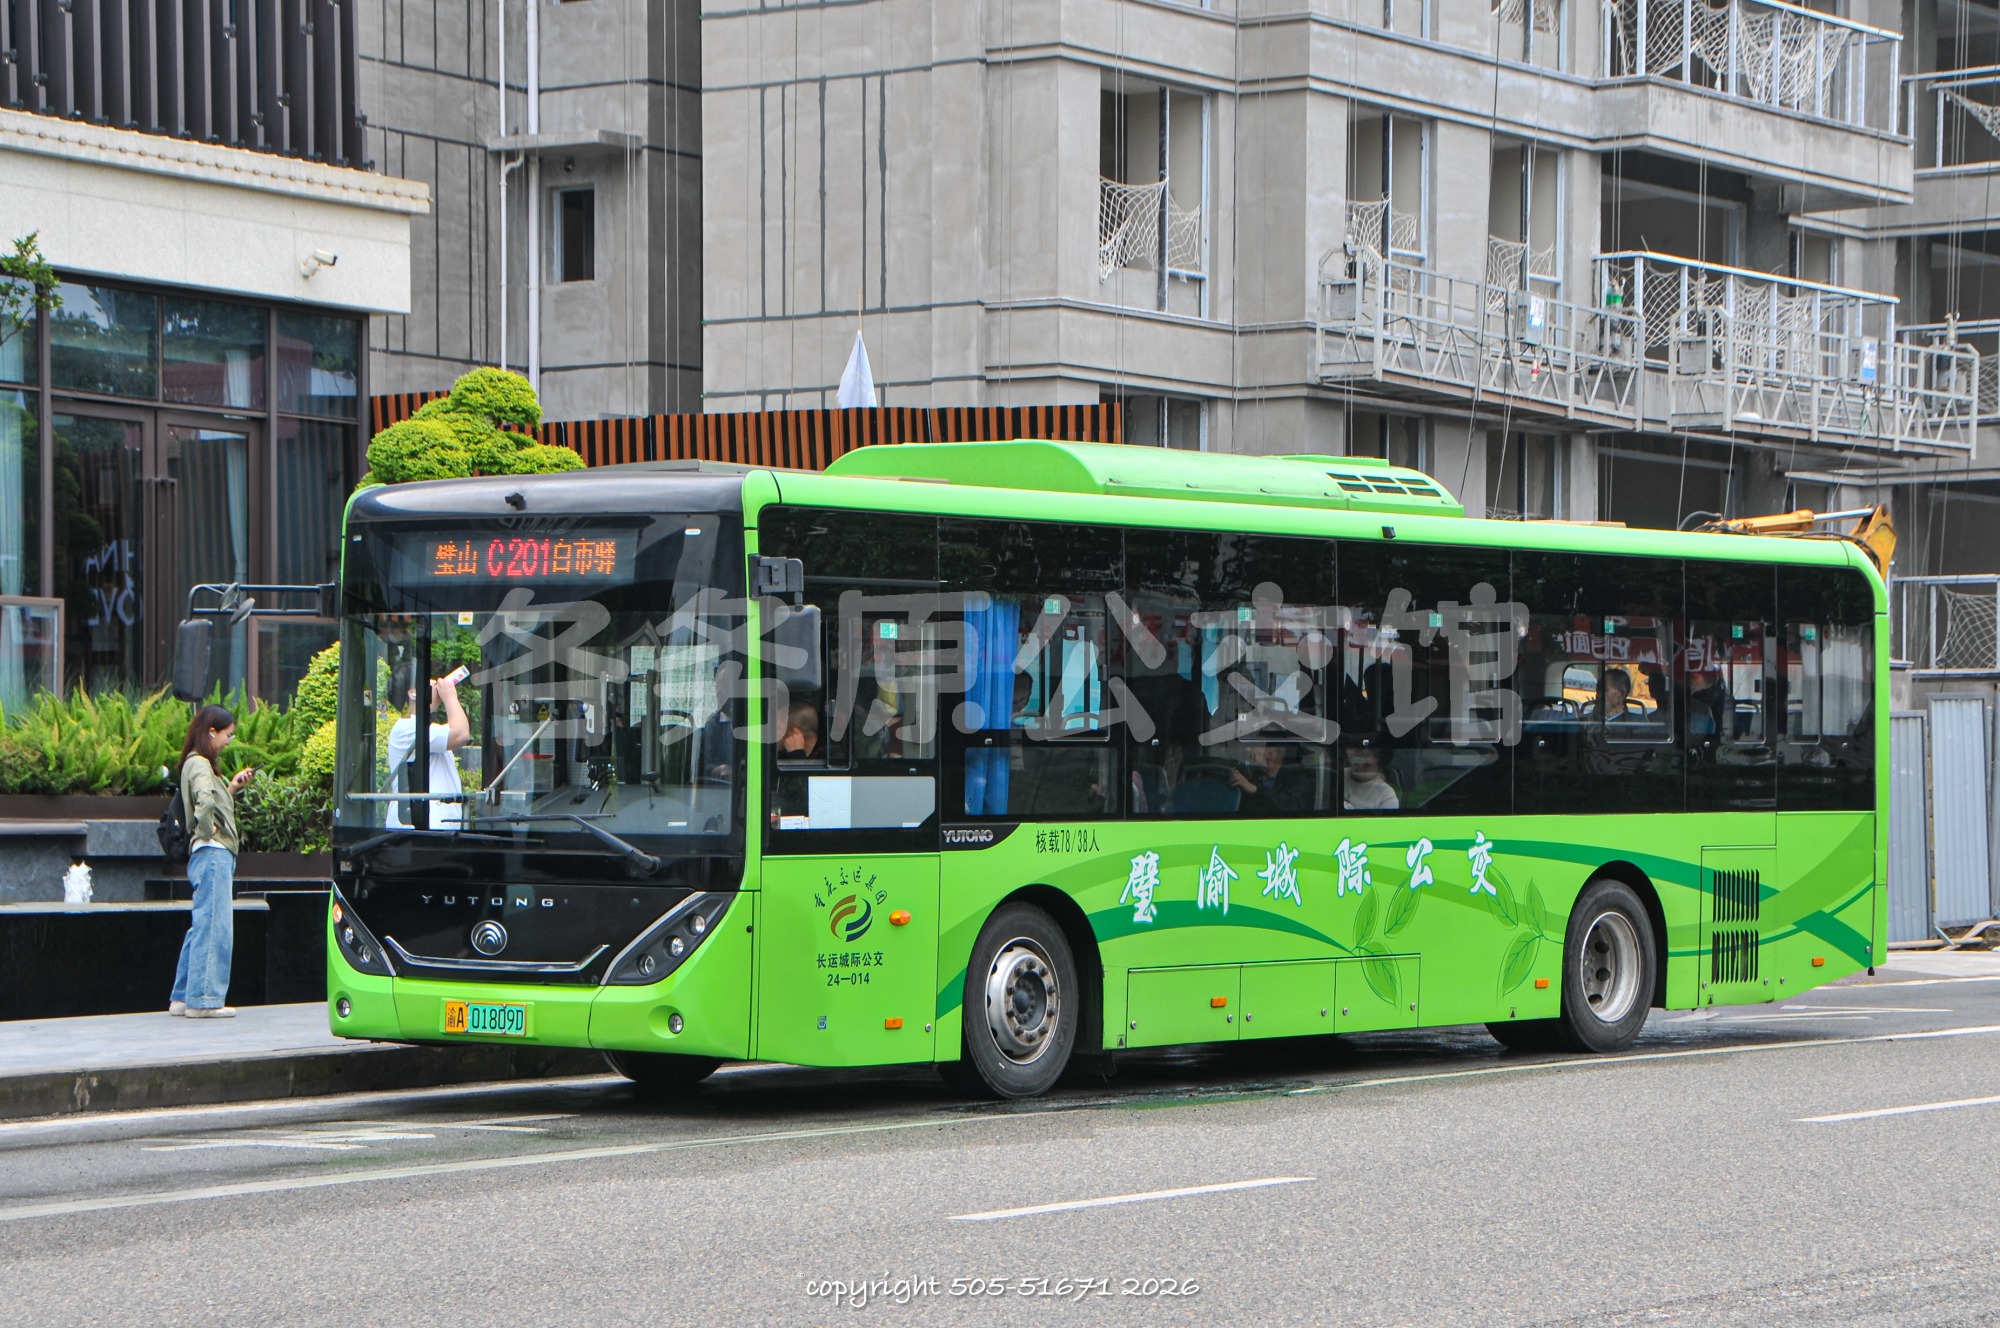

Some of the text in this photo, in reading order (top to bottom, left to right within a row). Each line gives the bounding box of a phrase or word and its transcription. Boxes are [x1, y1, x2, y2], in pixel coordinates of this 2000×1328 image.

[434, 538, 617, 577] 璧山 C201 白市驿
[943, 829, 994, 844] YUTONG
[1035, 829, 1100, 854] 核载78/38人
[421, 894, 554, 907] YUTONG
[816, 950, 884, 970] 长运城际公交
